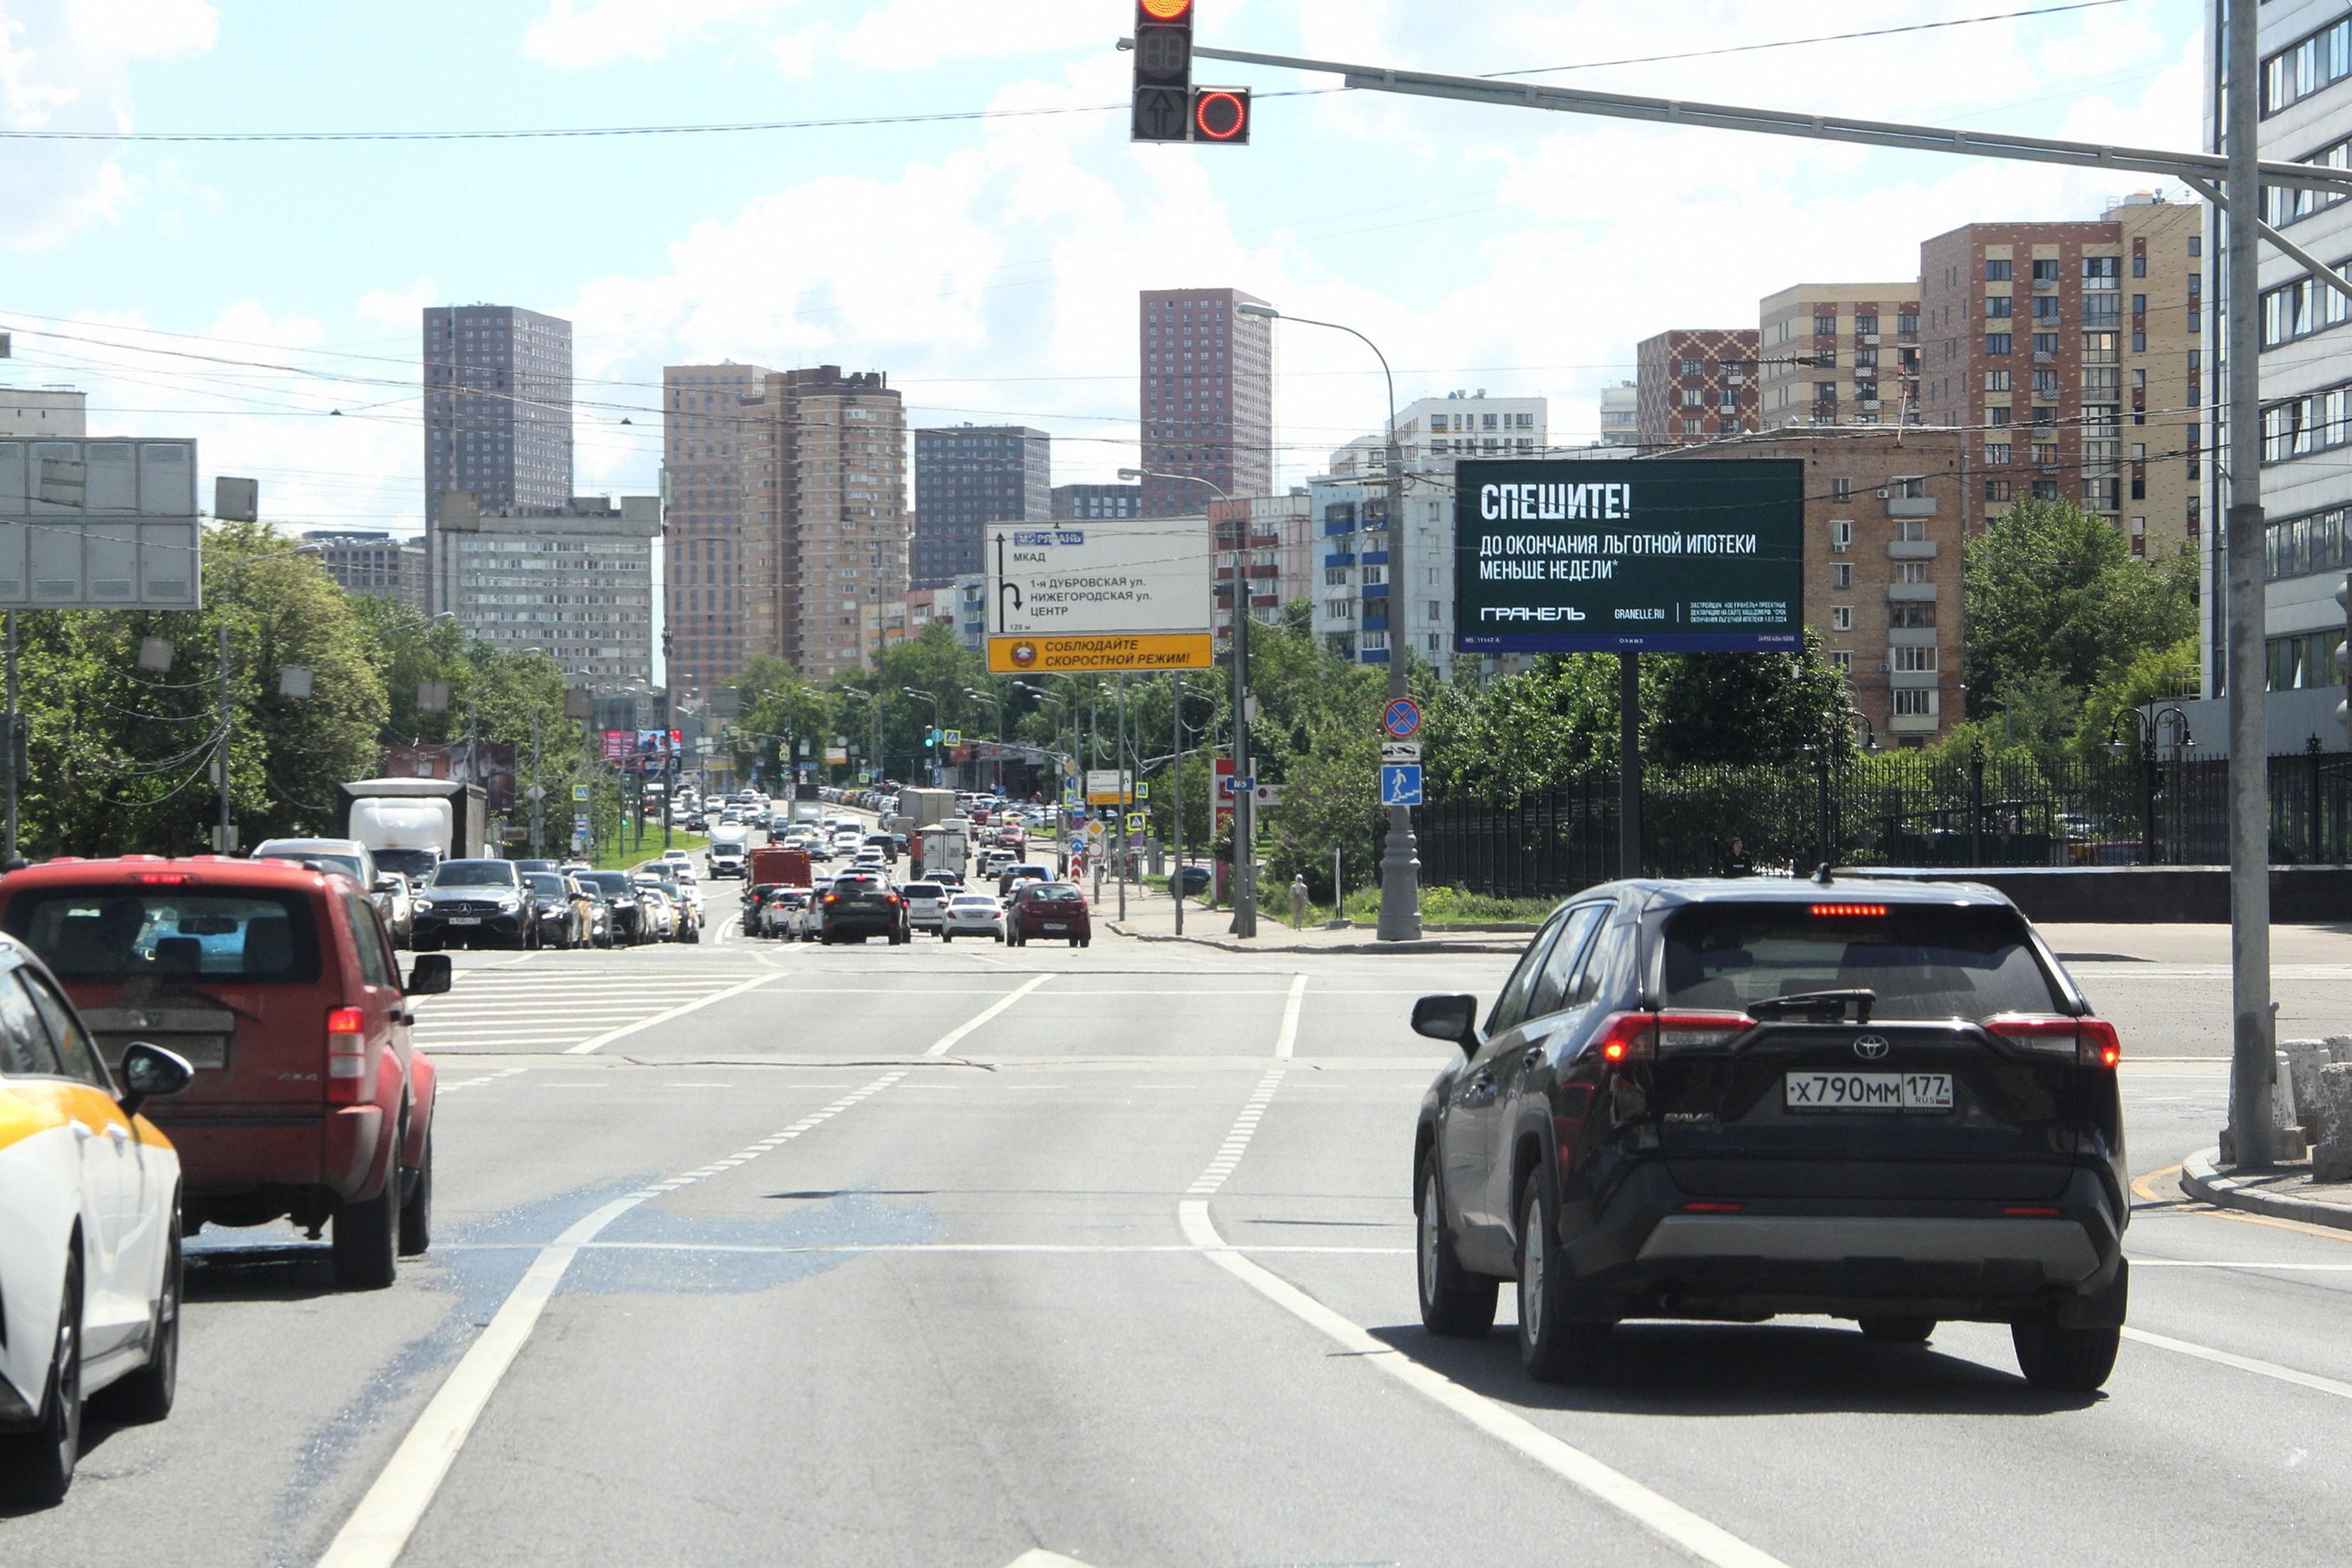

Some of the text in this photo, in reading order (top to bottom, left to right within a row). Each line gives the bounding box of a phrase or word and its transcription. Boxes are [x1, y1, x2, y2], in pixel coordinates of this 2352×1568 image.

[1480, 484, 1630, 520] СПЕШИТЕ!
[1037, 533, 1082, 544] РЯАНЬ
[1480, 531, 1756, 556] ДО ОКОНЧАНИЯ ЛЬГОТНОЙ ИПОТЕКИ
[1013, 553, 1046, 563] МКАД
[1480, 560, 1545, 580] МЕНЬШЕ
[1031, 577, 1146, 589] 1-я ДУБРОВСКАЯ ул.
[1030, 592, 1152, 602] НИЖЕГОРОДСКАЯ ул.
[1030, 607, 1068, 617] ЦЕНТР
[1480, 607, 1586, 621] ГРАНЕЛЬ
[1614, 609, 1665, 620] GRANELLE.RU
[1045, 639, 1139, 652] СОБЛЮДАЙТЕ
[1045, 653, 1190, 667] СКОРОСТНОЙ РЕЖИМ!
[1907, 1076, 1945, 1096] 177
